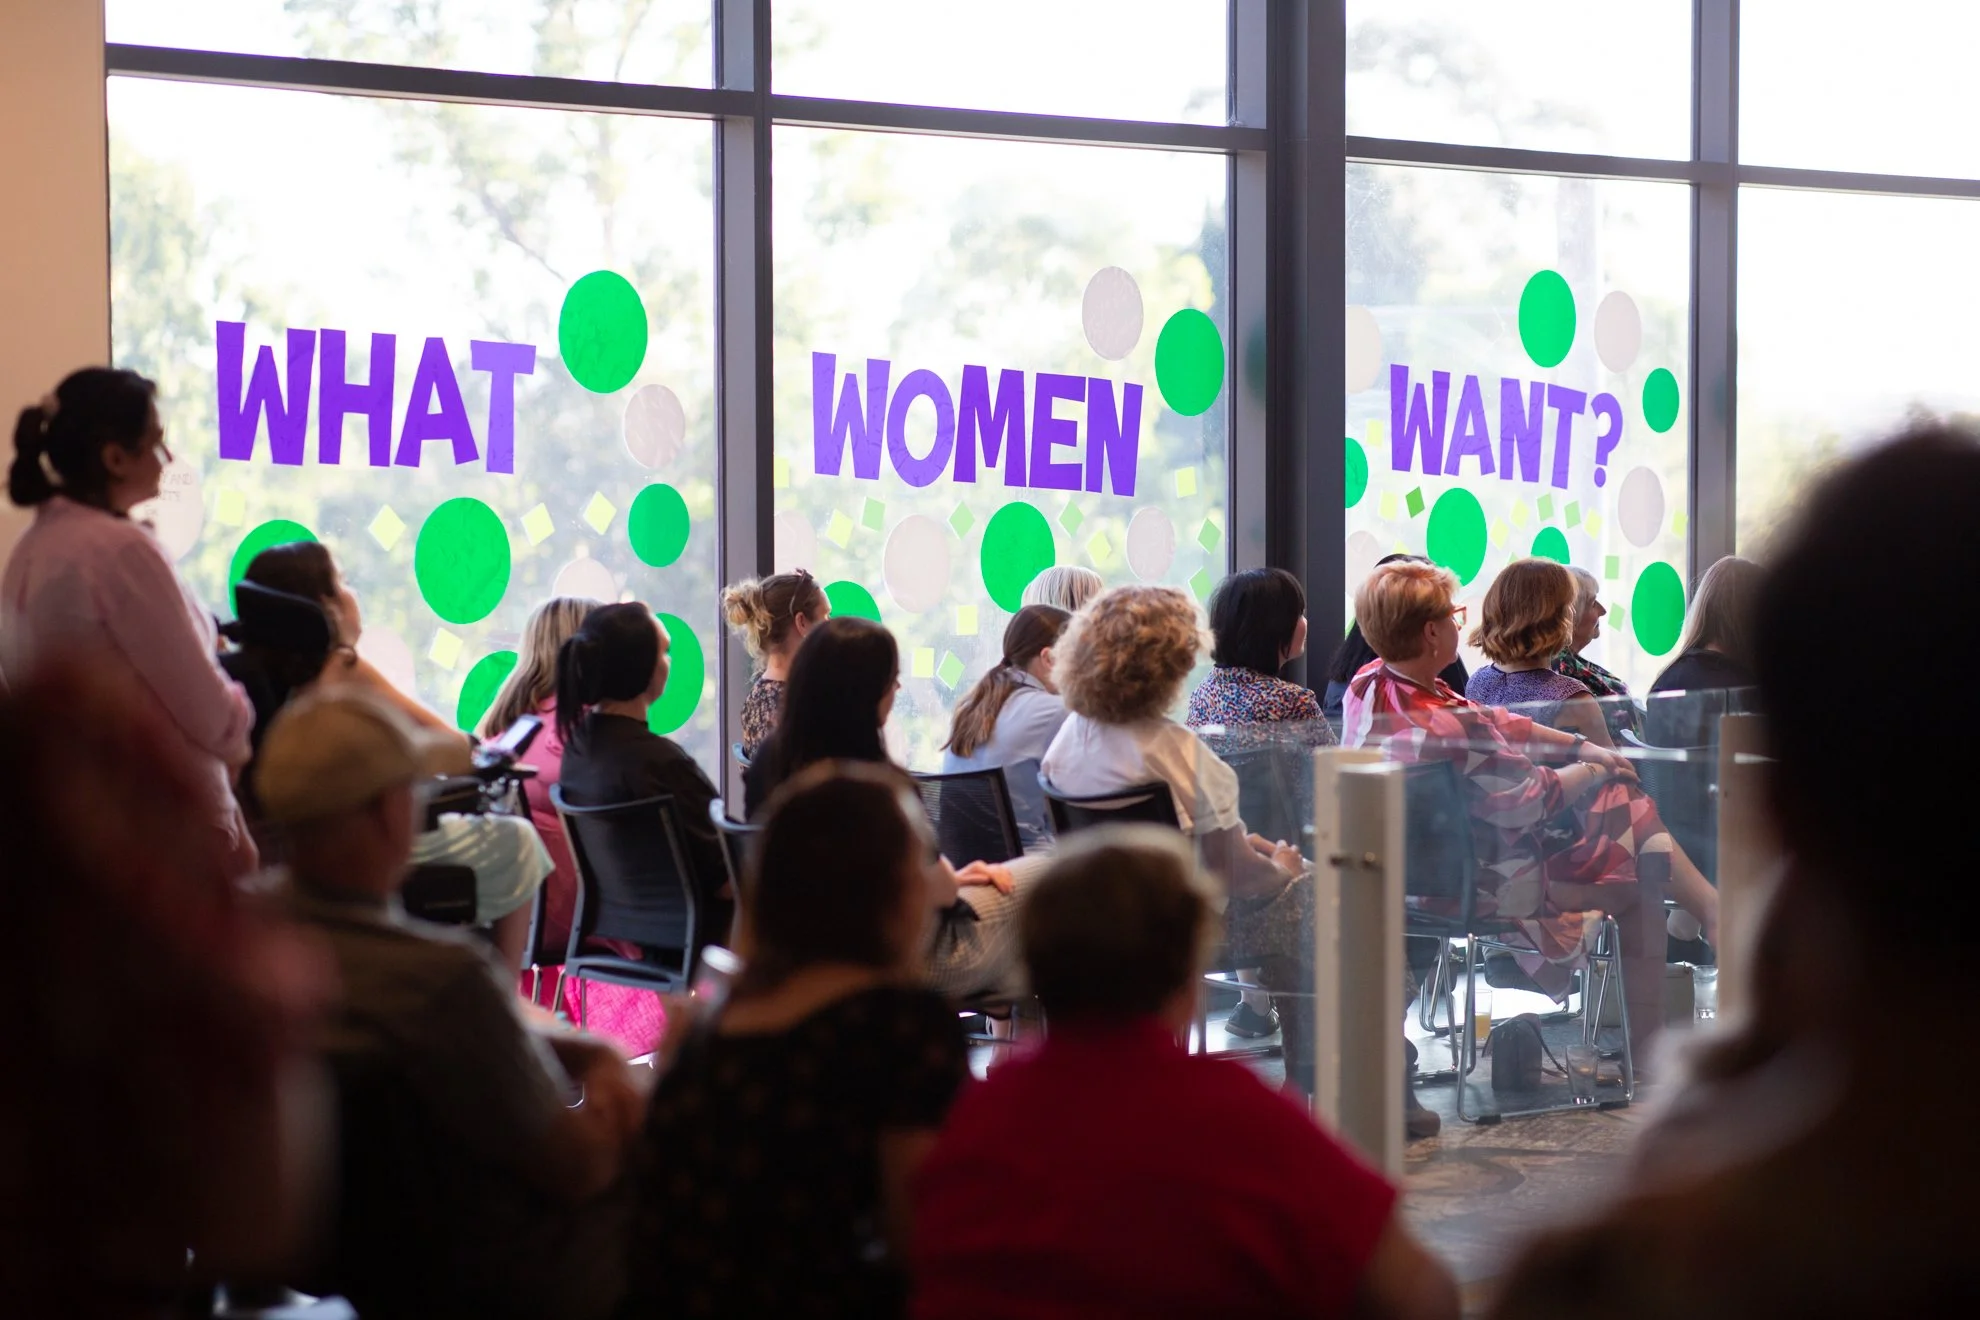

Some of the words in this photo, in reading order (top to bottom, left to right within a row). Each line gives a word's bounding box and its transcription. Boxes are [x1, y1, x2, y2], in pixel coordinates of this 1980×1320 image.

[215, 321, 536, 475] WHAT
[812, 352, 1144, 497] WOMEN
[1390, 364, 1624, 489] WANT?
